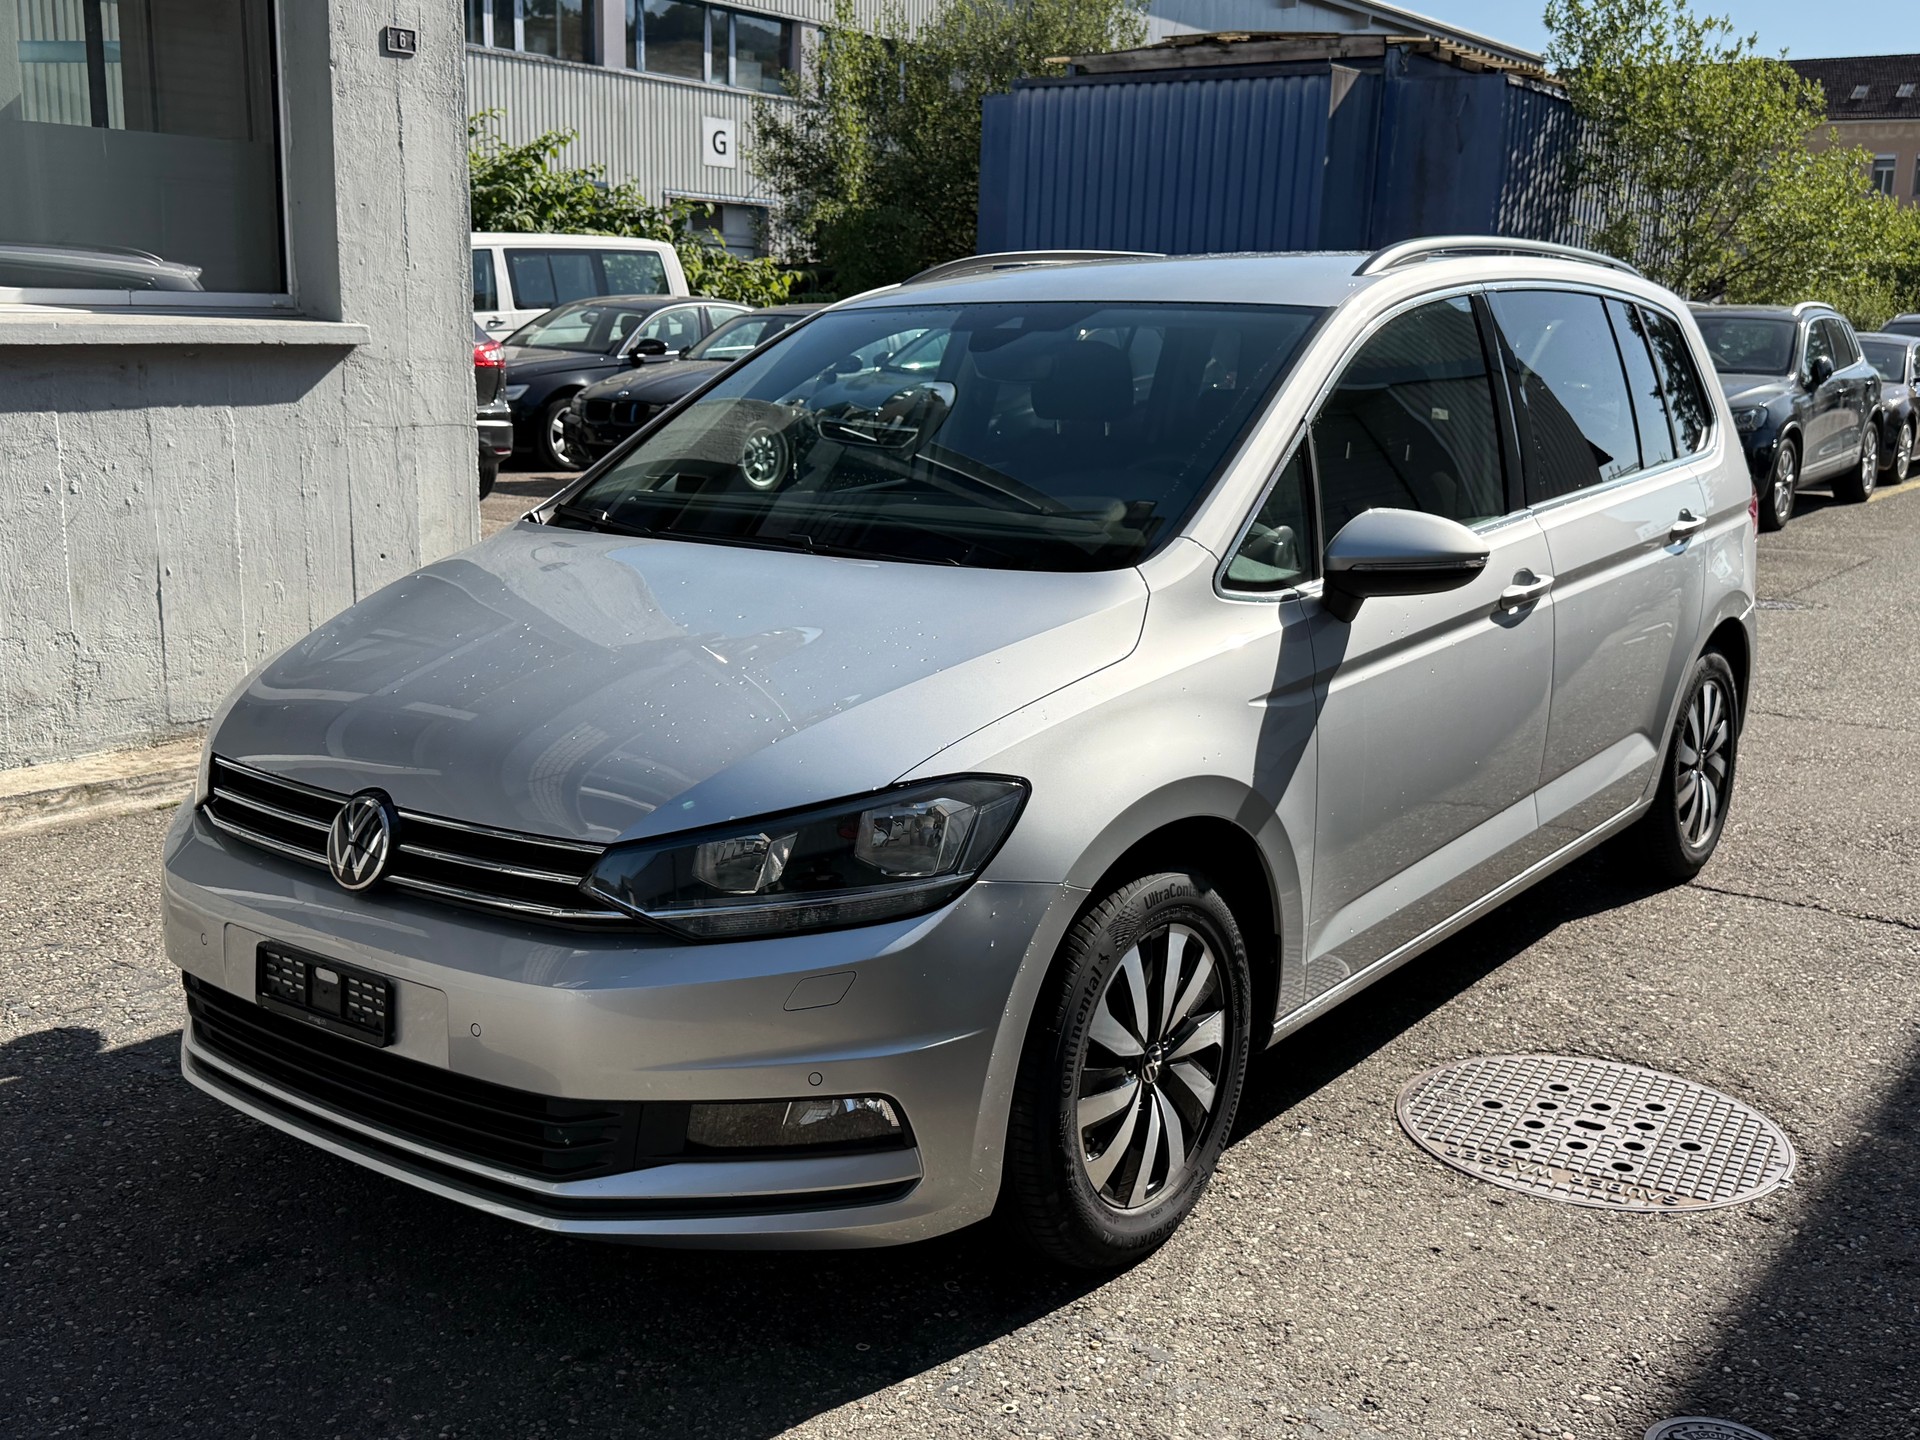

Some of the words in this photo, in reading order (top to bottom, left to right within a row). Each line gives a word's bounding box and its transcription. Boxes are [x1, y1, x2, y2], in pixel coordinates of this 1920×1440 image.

[399, 31, 406, 48] 6
[713, 130, 727, 155] G
[1061, 966, 1103, 1099] Continental
[1445, 1145, 1554, 1179] WASSER
[1569, 1172, 1680, 1206] SAUBER
